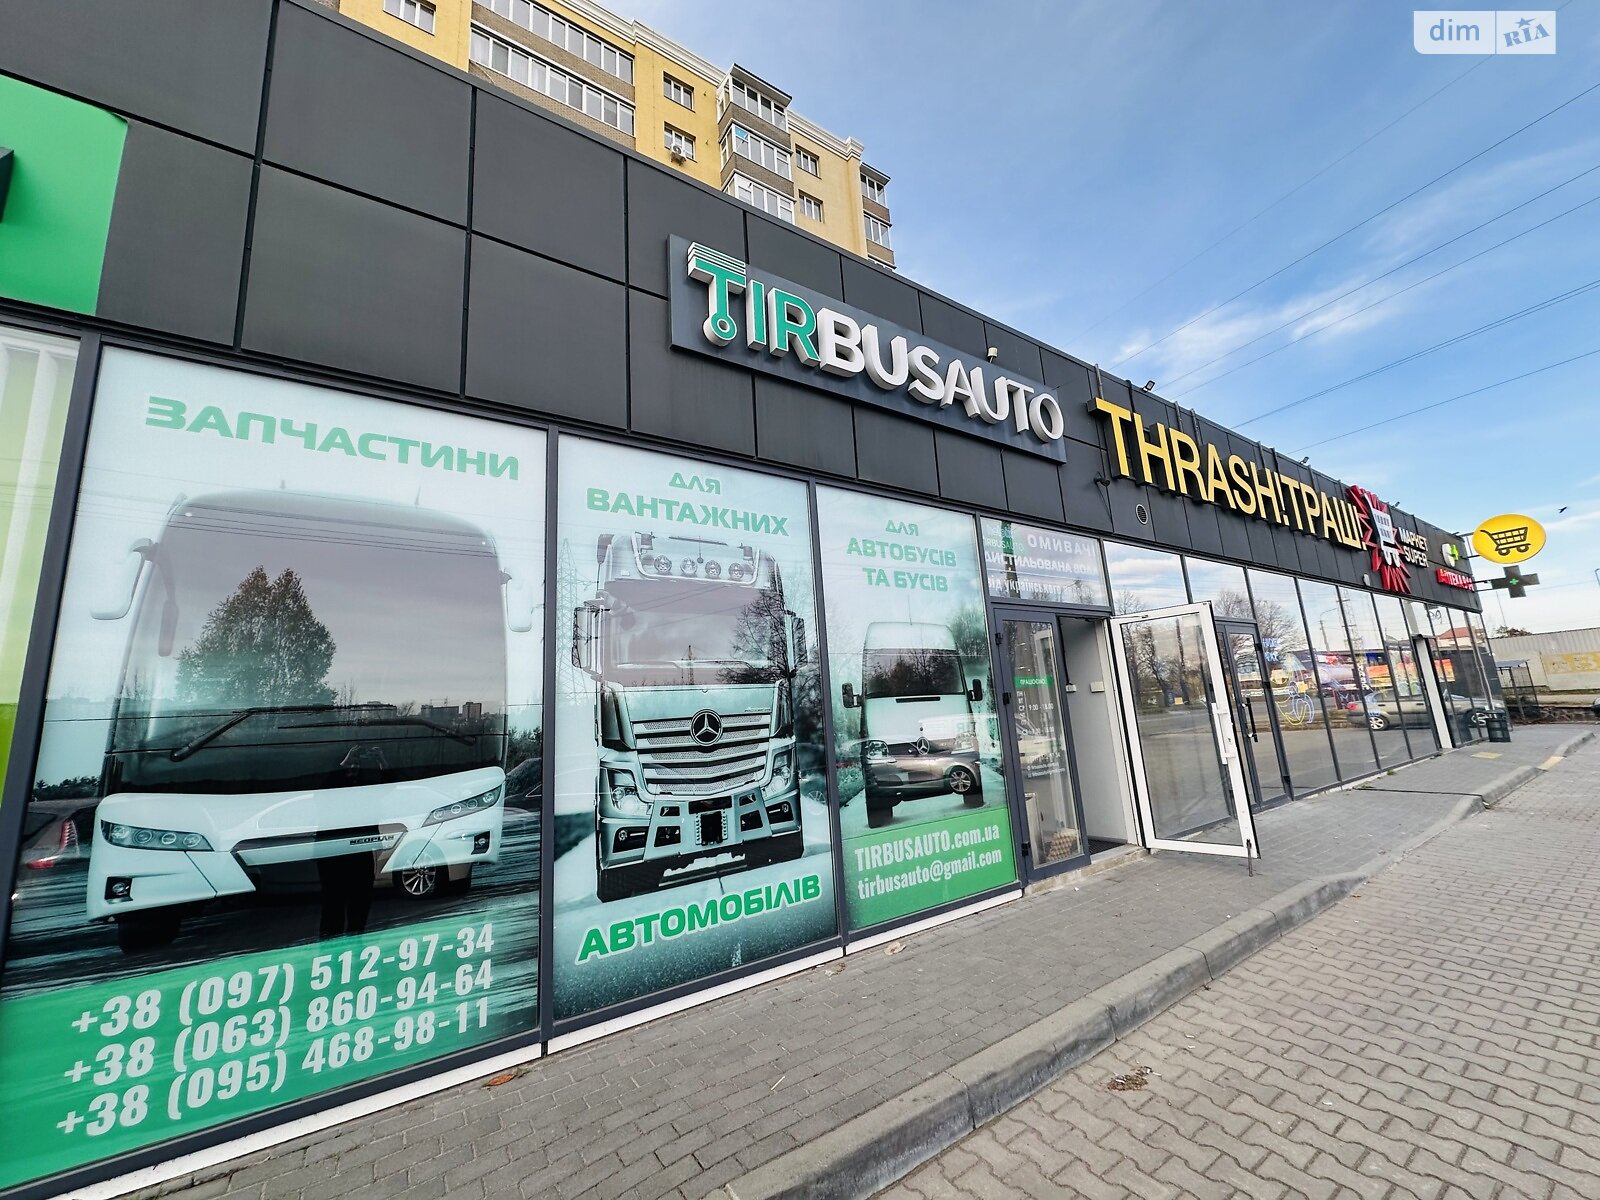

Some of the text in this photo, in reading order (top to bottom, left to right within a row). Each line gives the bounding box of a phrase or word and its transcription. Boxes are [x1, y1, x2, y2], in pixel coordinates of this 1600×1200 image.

[687, 241, 1065, 444] TIRBUSAUTO
[145, 395, 520, 480] ЗАПЧАСТИНИ
[668, 471, 721, 495] ДЛЯ
[586, 487, 790, 537] ВАНТАЖНИХ
[885, 519, 919, 537] ДЛЯ
[846, 537, 957, 567] АВТОБУСІВ
[1403, 545, 1430, 568] SUPER
[862, 567, 949, 593] ТА БУСІВ
[854, 824, 1001, 872] TIRBUSAUTO.com.ua
[857, 847, 1002, 900] tirbusauto@gmail.com
[575, 873, 822, 964] АВТОМОБІЛІВ
[71, 923, 495, 1036] +38 (097) 512-97-34
[64, 959, 494, 1085] +38 (063) 860-94-64
[56, 997, 489, 1137] +38 (095) 468-98-11
